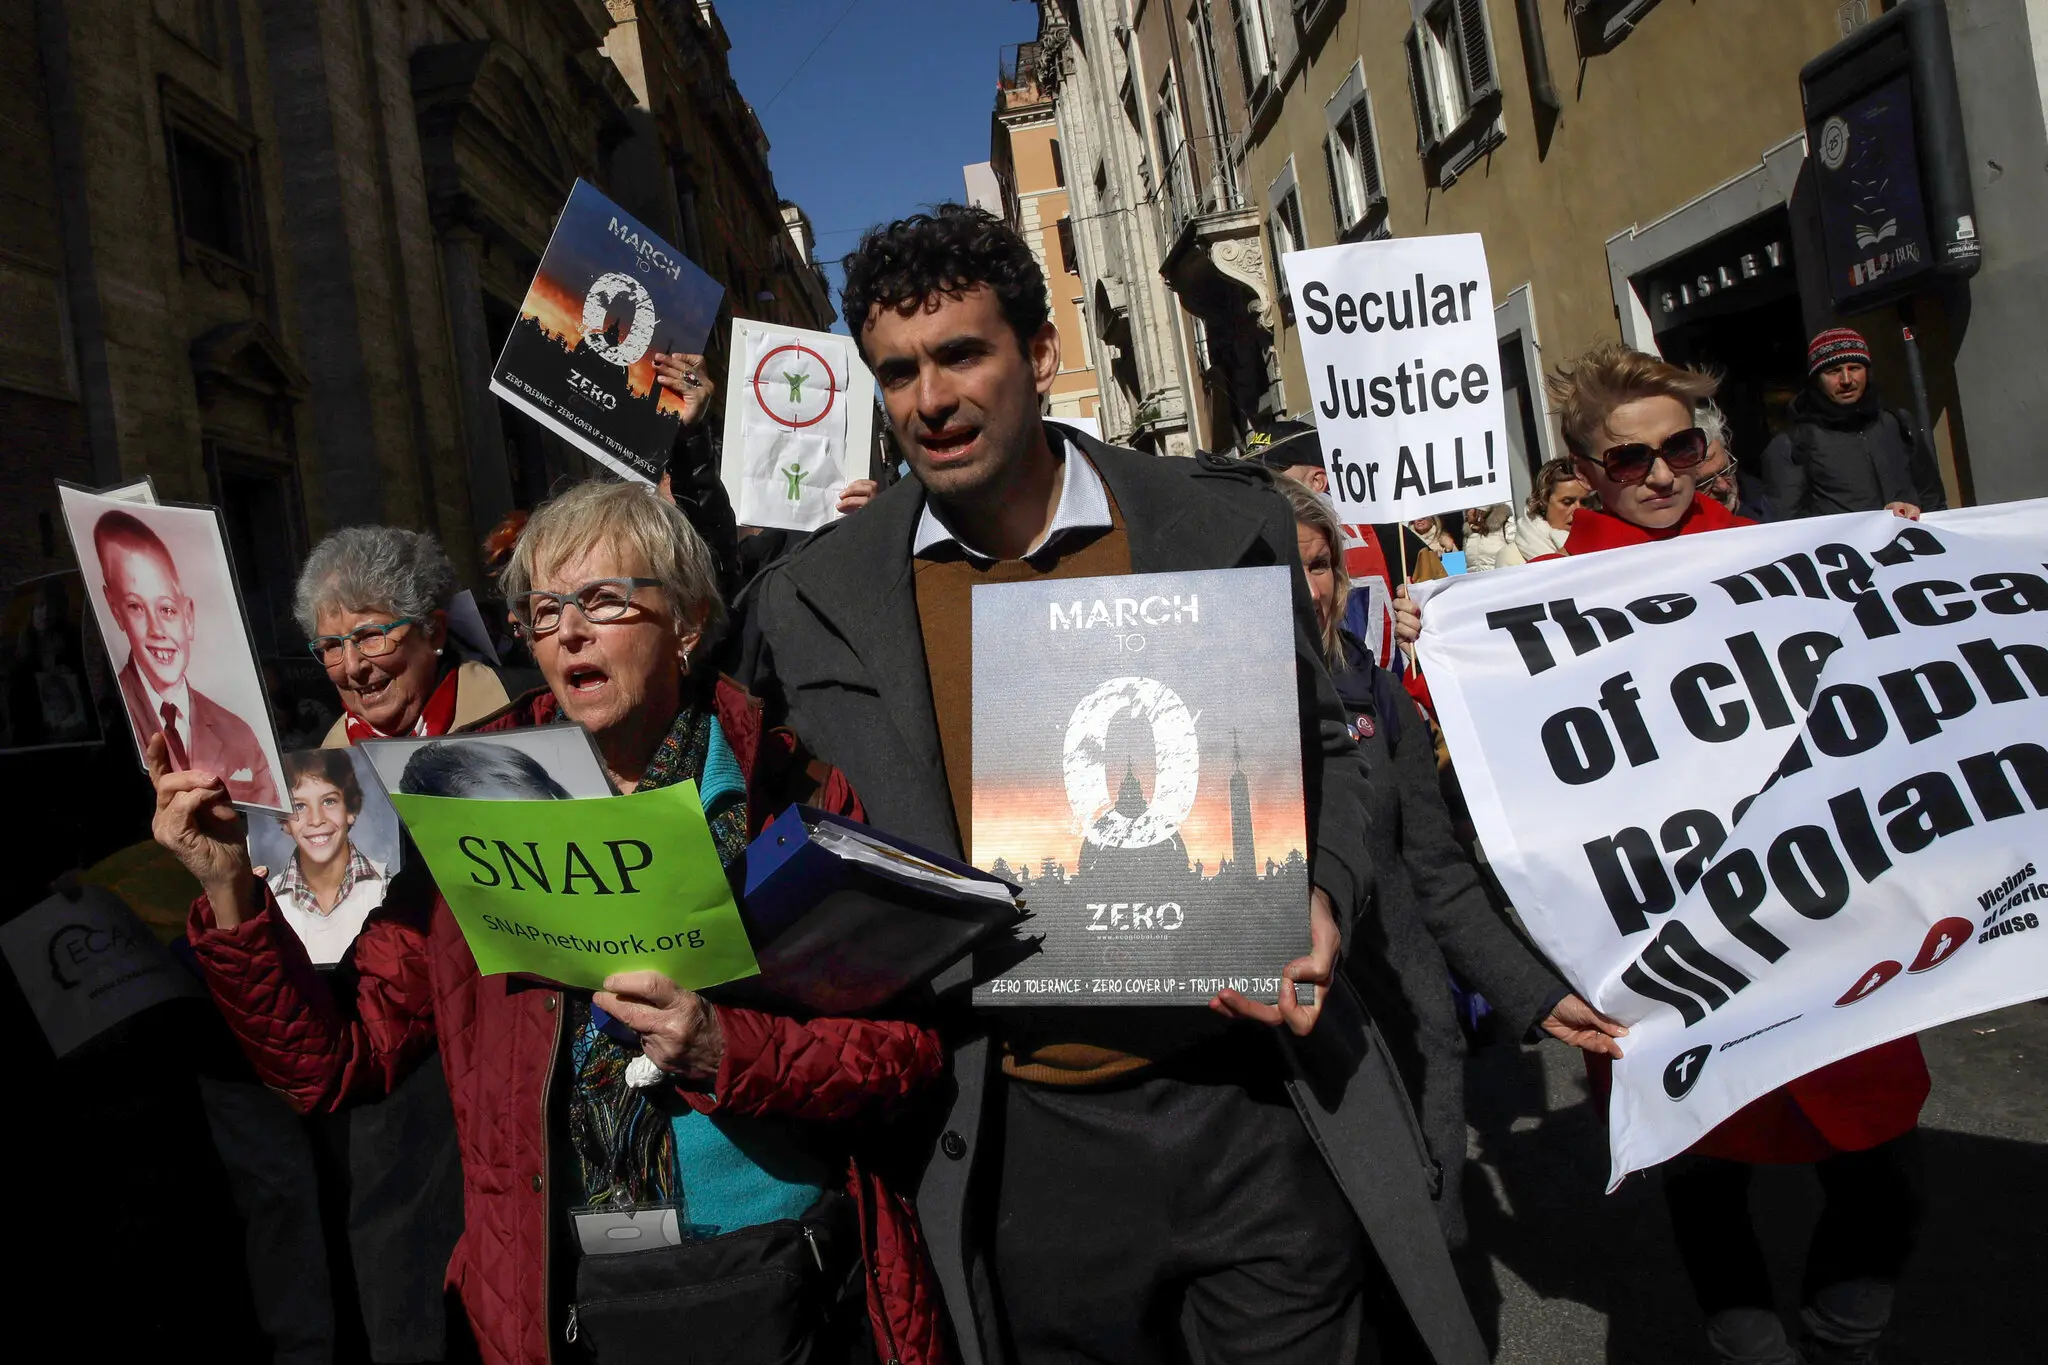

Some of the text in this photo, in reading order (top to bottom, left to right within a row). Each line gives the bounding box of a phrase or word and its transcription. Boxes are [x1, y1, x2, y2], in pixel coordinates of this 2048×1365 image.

[607, 216, 682, 281] MARCH
[635, 256, 651, 273] TO
[1661, 241, 1784, 312] SISLEY
[1302, 273, 1478, 335] Secular
[567, 369, 617, 410] ZERO
[1320, 358, 1490, 420] Justice
[505, 372, 523, 387] ZERO
[523, 382, 554, 408] TOLERANCE
[557, 406, 574, 421] ZERO
[574, 416, 593, 434] COVER
[592, 429, 601, 438] UP
[605, 436, 623, 453] TRUTH
[622, 448, 634, 461] AND
[1331, 431, 1496, 503] for ALL!
[1049, 594, 1199, 630] MARCH
[1486, 528, 1946, 677] The map
[1114, 633, 1146, 652] TO
[1541, 671, 1660, 785] of
[458, 836, 653, 896] SNAP
[1977, 863, 2037, 912] Victims
[482, 914, 706, 956] SNAPnetwork.org
[1085, 902, 1184, 931] ZERO
[1983, 909, 1998, 928] of
[991, 979, 1021, 993] ZERO
[1023, 978, 1081, 993] TOLERANCE
[1092, 978, 1122, 992] ZERO
[1125, 978, 1161, 992] COVER
[1163, 977, 1177, 992] UP
[1190, 977, 1225, 992] TRUTH
[1227, 977, 1249, 992] AND
